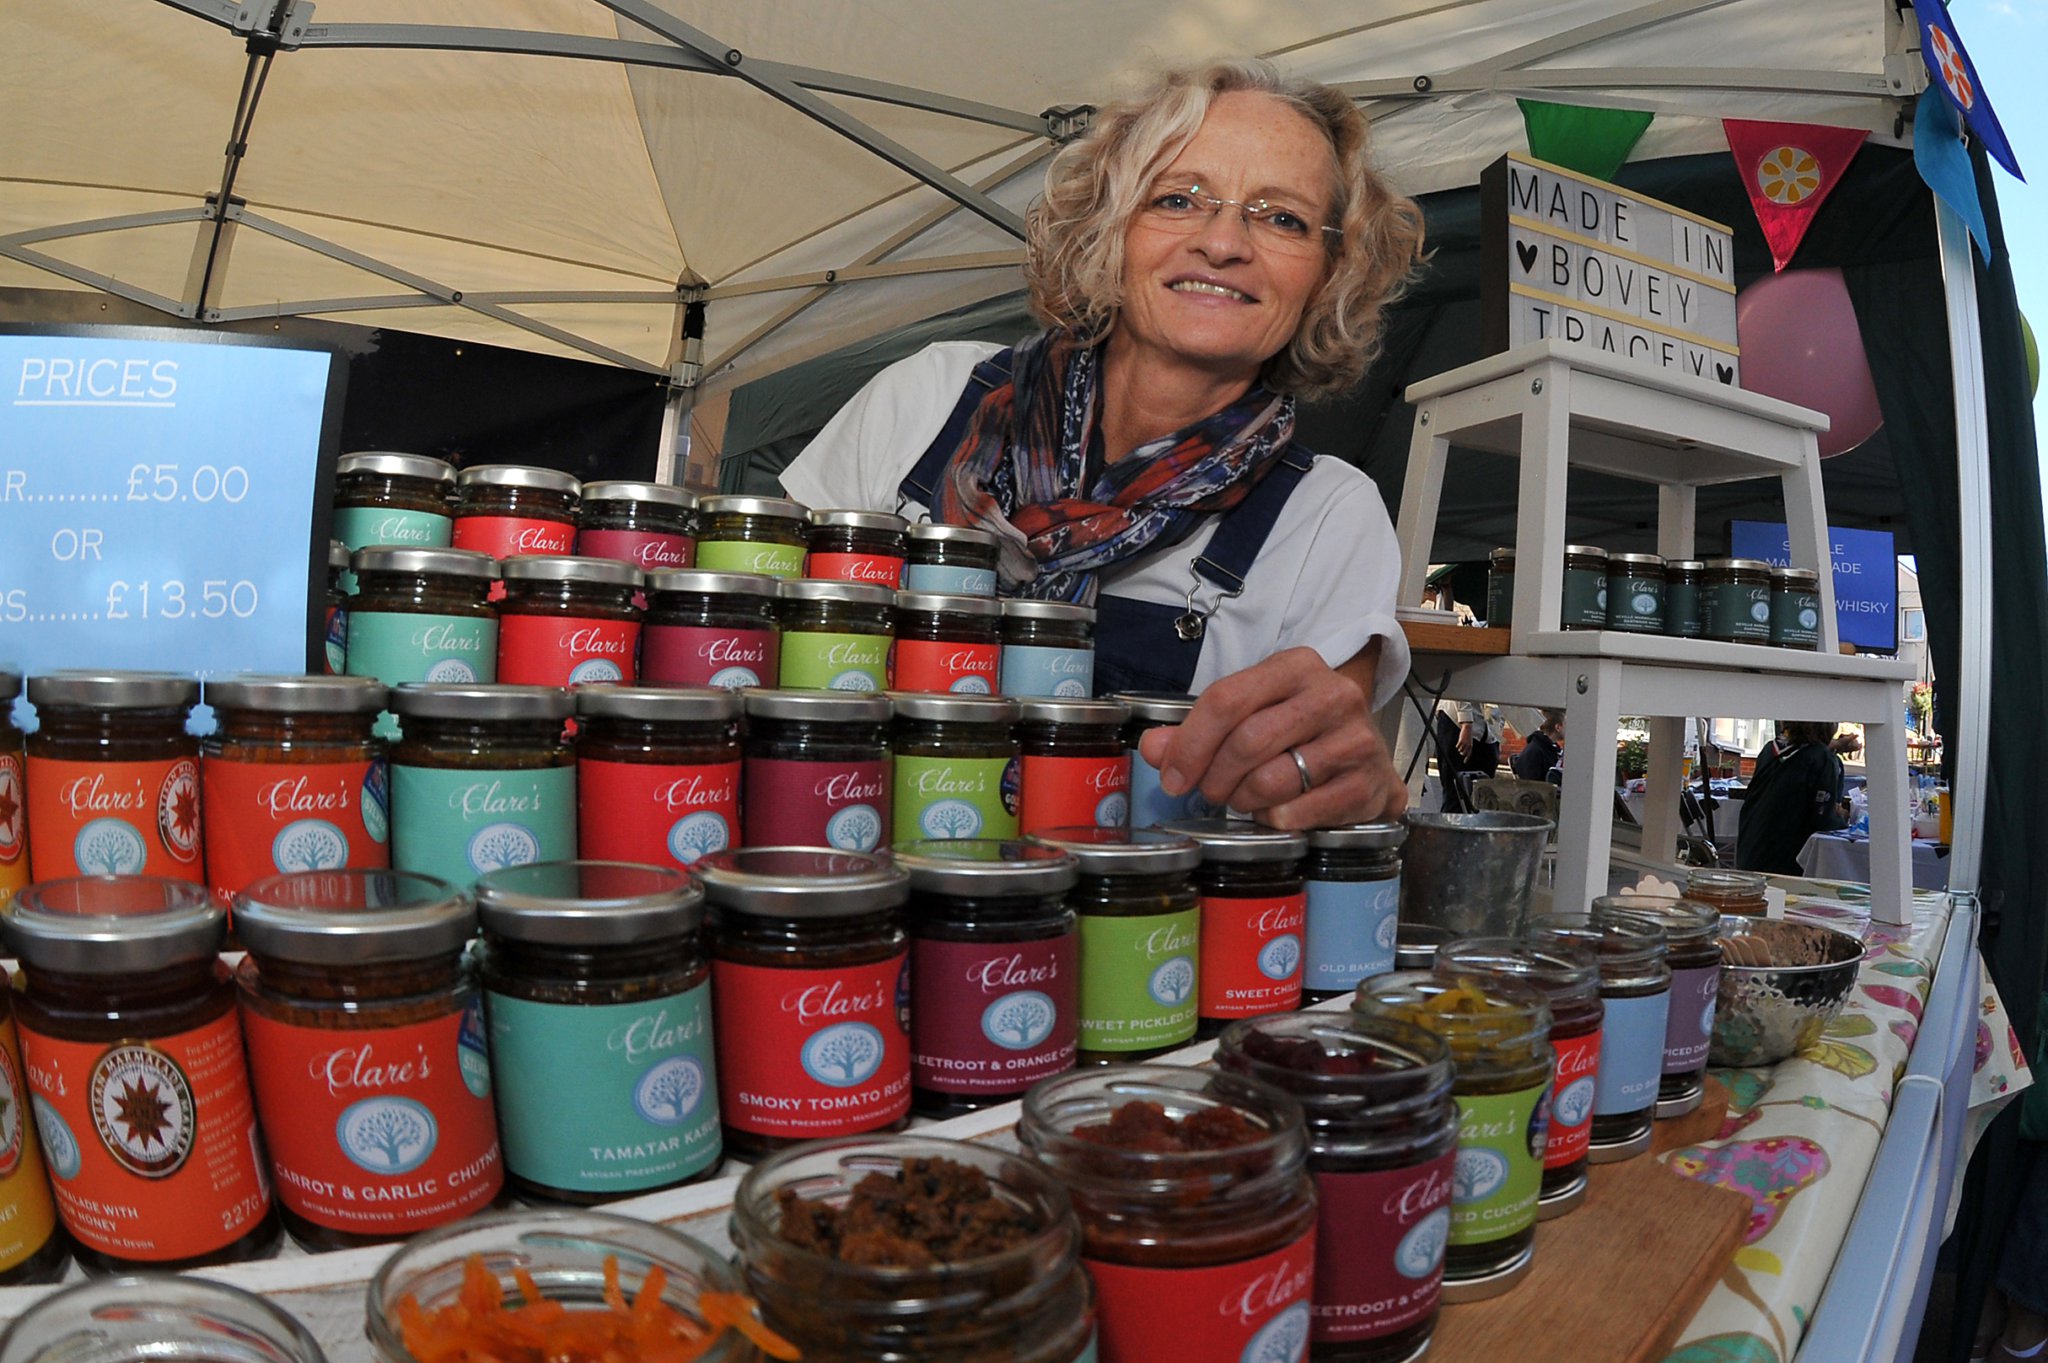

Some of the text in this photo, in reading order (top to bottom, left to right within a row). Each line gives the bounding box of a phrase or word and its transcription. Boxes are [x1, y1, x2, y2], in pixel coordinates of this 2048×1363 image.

[1510, 167, 1723, 274] MADE IN
[1552, 244, 1691, 323] BOVEY
[18, 358, 179, 398] PRICES
[52, 527, 103, 561] OR
[370, 515, 432, 546] Clare's
[510, 527, 566, 554] Clare's
[633, 541, 686, 567] Clare's
[745, 550, 798, 575] Clare's
[841, 561, 895, 583] Clare's
[1627, 580, 1658, 594] Clare's
[411, 623, 481, 656] Clare's
[559, 628, 626, 660] Clare's
[699, 638, 764, 670] Clare's
[818, 642, 880, 672] Clare's
[940, 650, 994, 676] Clare's
[1043, 654, 1089, 677] Clare's
[60, 773, 147, 820] Clare's
[257, 776, 348, 821] Clare's
[653, 775, 730, 814] Clare's
[814, 773, 883, 807] Clare's
[907, 767, 985, 799] Clare's
[449, 780, 541, 823] Clare's
[966, 952, 1059, 994] Clare's
[1320, 963, 1345, 973] OLD
[781, 979, 884, 1027] Clare's
[1226, 988, 1270, 999] SWEET
[1130, 1012, 1183, 1030] PICKLED
[607, 1009, 703, 1065] Clare's
[25, 1040, 67, 1096] lare's
[309, 1042, 432, 1098] Clare's
[991, 1060, 1001, 1071] &
[1006, 1051, 1059, 1070] ORANGE
[739, 1092, 801, 1111] SMOKY
[808, 1090, 880, 1111] TOMATO
[1622, 1083, 1643, 1094] OLD
[1459, 1108, 1517, 1139] lare's
[589, 1136, 680, 1161] TAMATAR
[1547, 1137, 1565, 1148] ET
[275, 1160, 336, 1198] CARROT
[342, 1186, 356, 1201] &
[362, 1180, 438, 1202] GARLIC
[78, 1210, 117, 1232] HONEY
[102, 1203, 139, 1219] WITH
[1398, 1295, 1408, 1306] &
